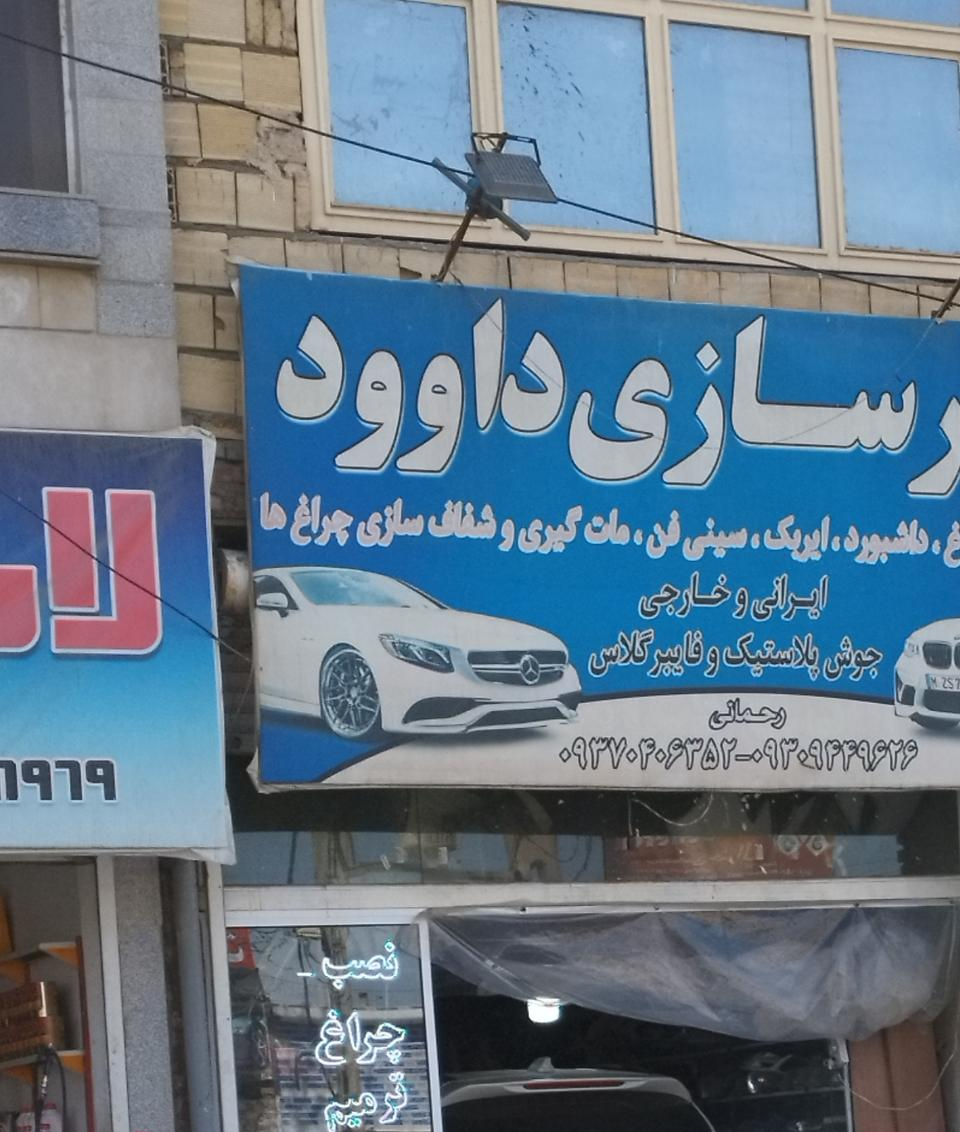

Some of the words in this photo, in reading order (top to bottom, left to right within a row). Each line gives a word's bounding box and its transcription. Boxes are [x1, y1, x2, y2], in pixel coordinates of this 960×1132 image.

[276, 298, 566, 474] داوود
[568, 315, 916, 487] سازی
[259, 491, 287, 530] ها
[290, 492, 354, 546] چراغ
[356, 498, 424, 547] سازی
[427, 500, 497, 539] شفاف
[518, 505, 582, 554] گیری
[584, 508, 630, 545] مات
[498, 518, 515, 551] و
[682, 517, 747, 561] سینی
[0, 486, 163, 654] لا
[638, 571, 731, 619] خارجی
[732, 586, 749, 619] و
[751, 573, 829, 620] ایرانی
[704, 646, 720, 677] و
[722, 631, 819, 681] پلاستیک
[823, 635, 883, 682] جوش
[709, 698, 787, 730] رحمانی
[322, 941, 400, 990] نصب
[314, 1009, 406, 1066] چراغ
